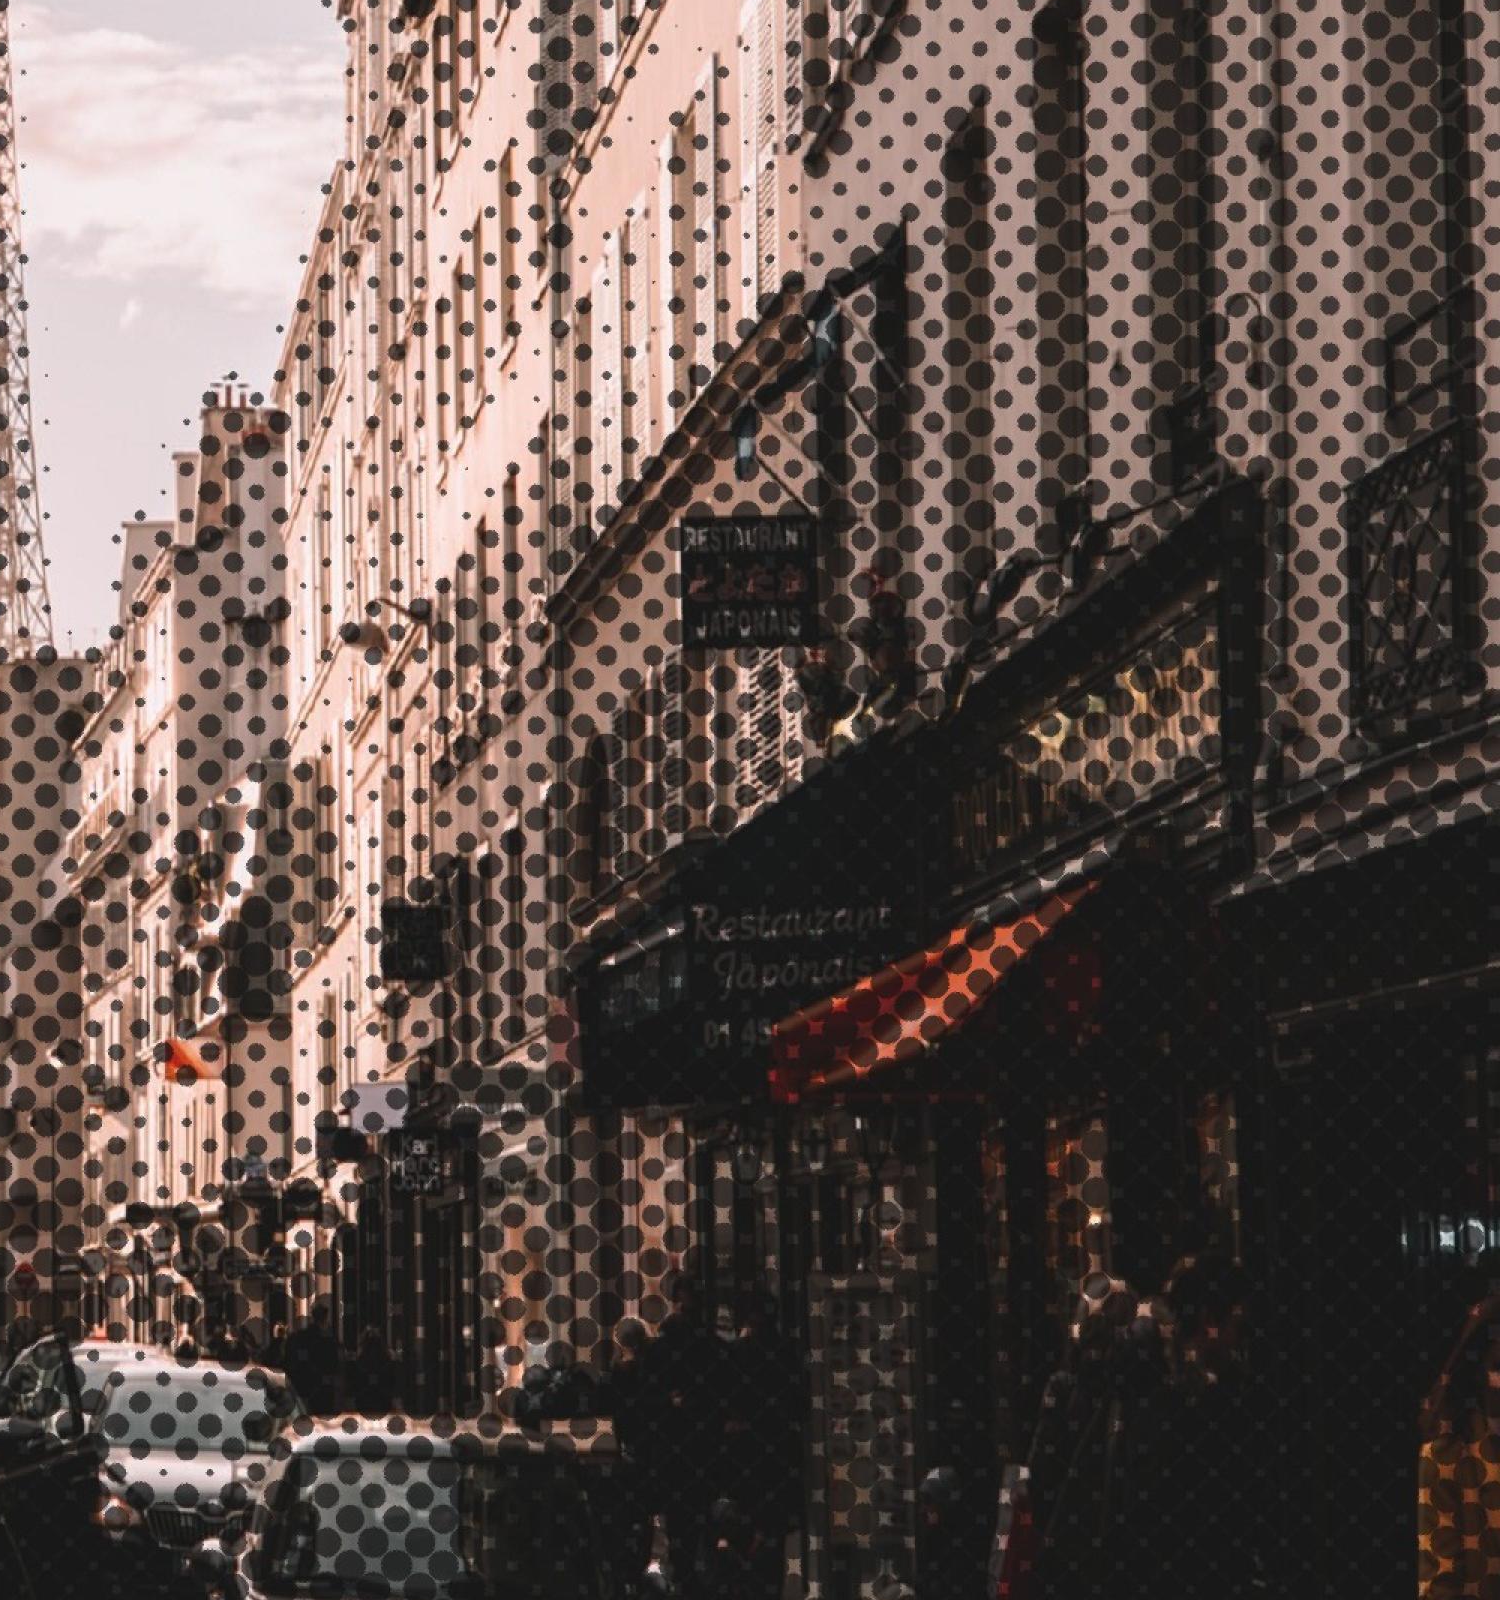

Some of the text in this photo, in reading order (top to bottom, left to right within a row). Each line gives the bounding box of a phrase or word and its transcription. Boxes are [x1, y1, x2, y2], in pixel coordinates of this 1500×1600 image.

[683, 522, 810, 552] RESTAURANT
[695, 606, 801, 640] JAPONAIS
[691, 897, 893, 943] Restaurant
[712, 949, 873, 1001] Japonais
